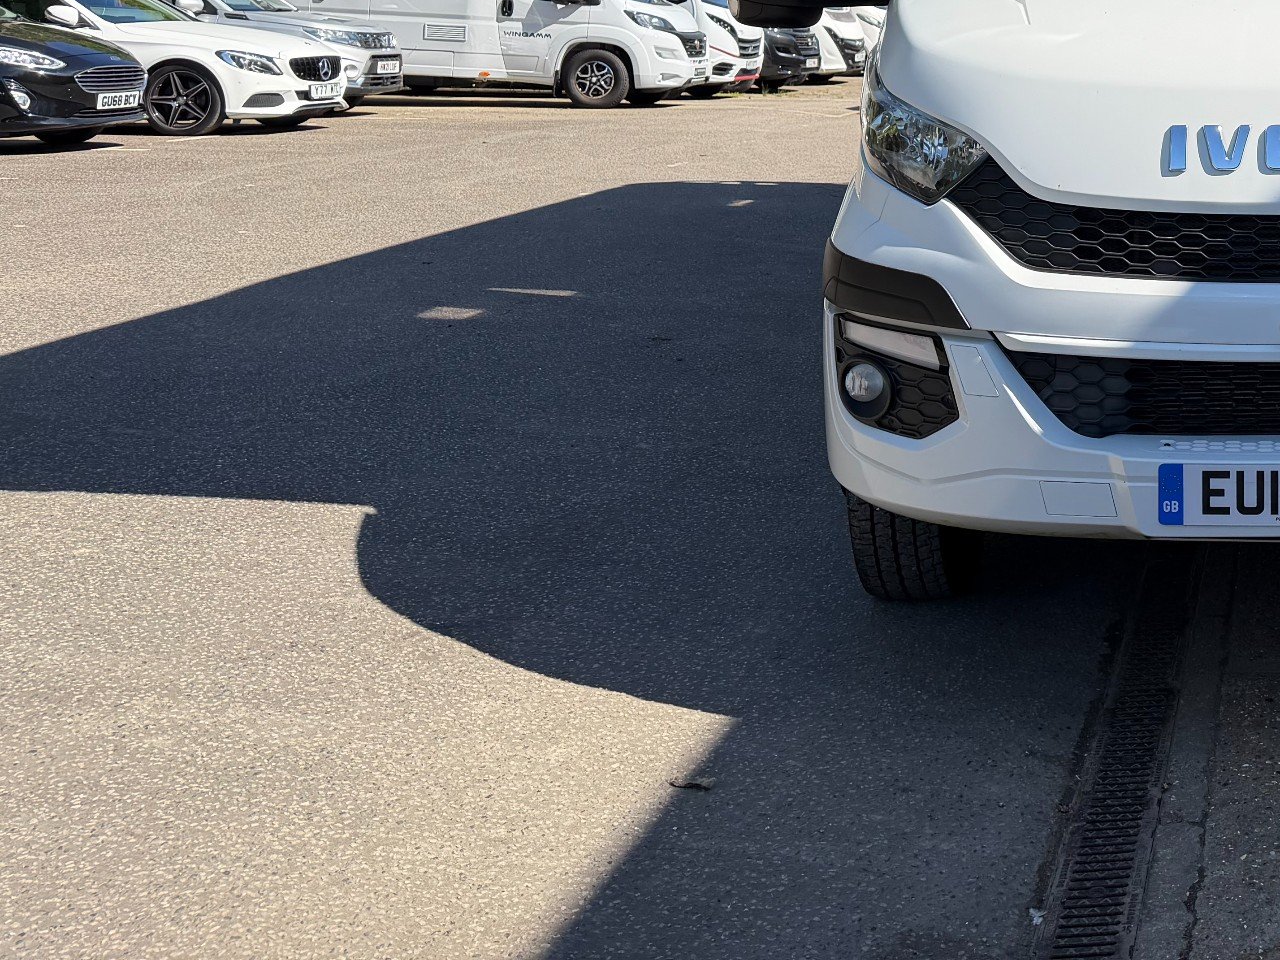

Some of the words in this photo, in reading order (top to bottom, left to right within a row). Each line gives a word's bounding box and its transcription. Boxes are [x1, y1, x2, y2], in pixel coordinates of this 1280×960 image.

[503, 30, 552, 39] WINGAMM
[101, 95, 123, 107] GU68
[123, 94, 138, 106] BCY
[1162, 500, 1179, 513] GB
